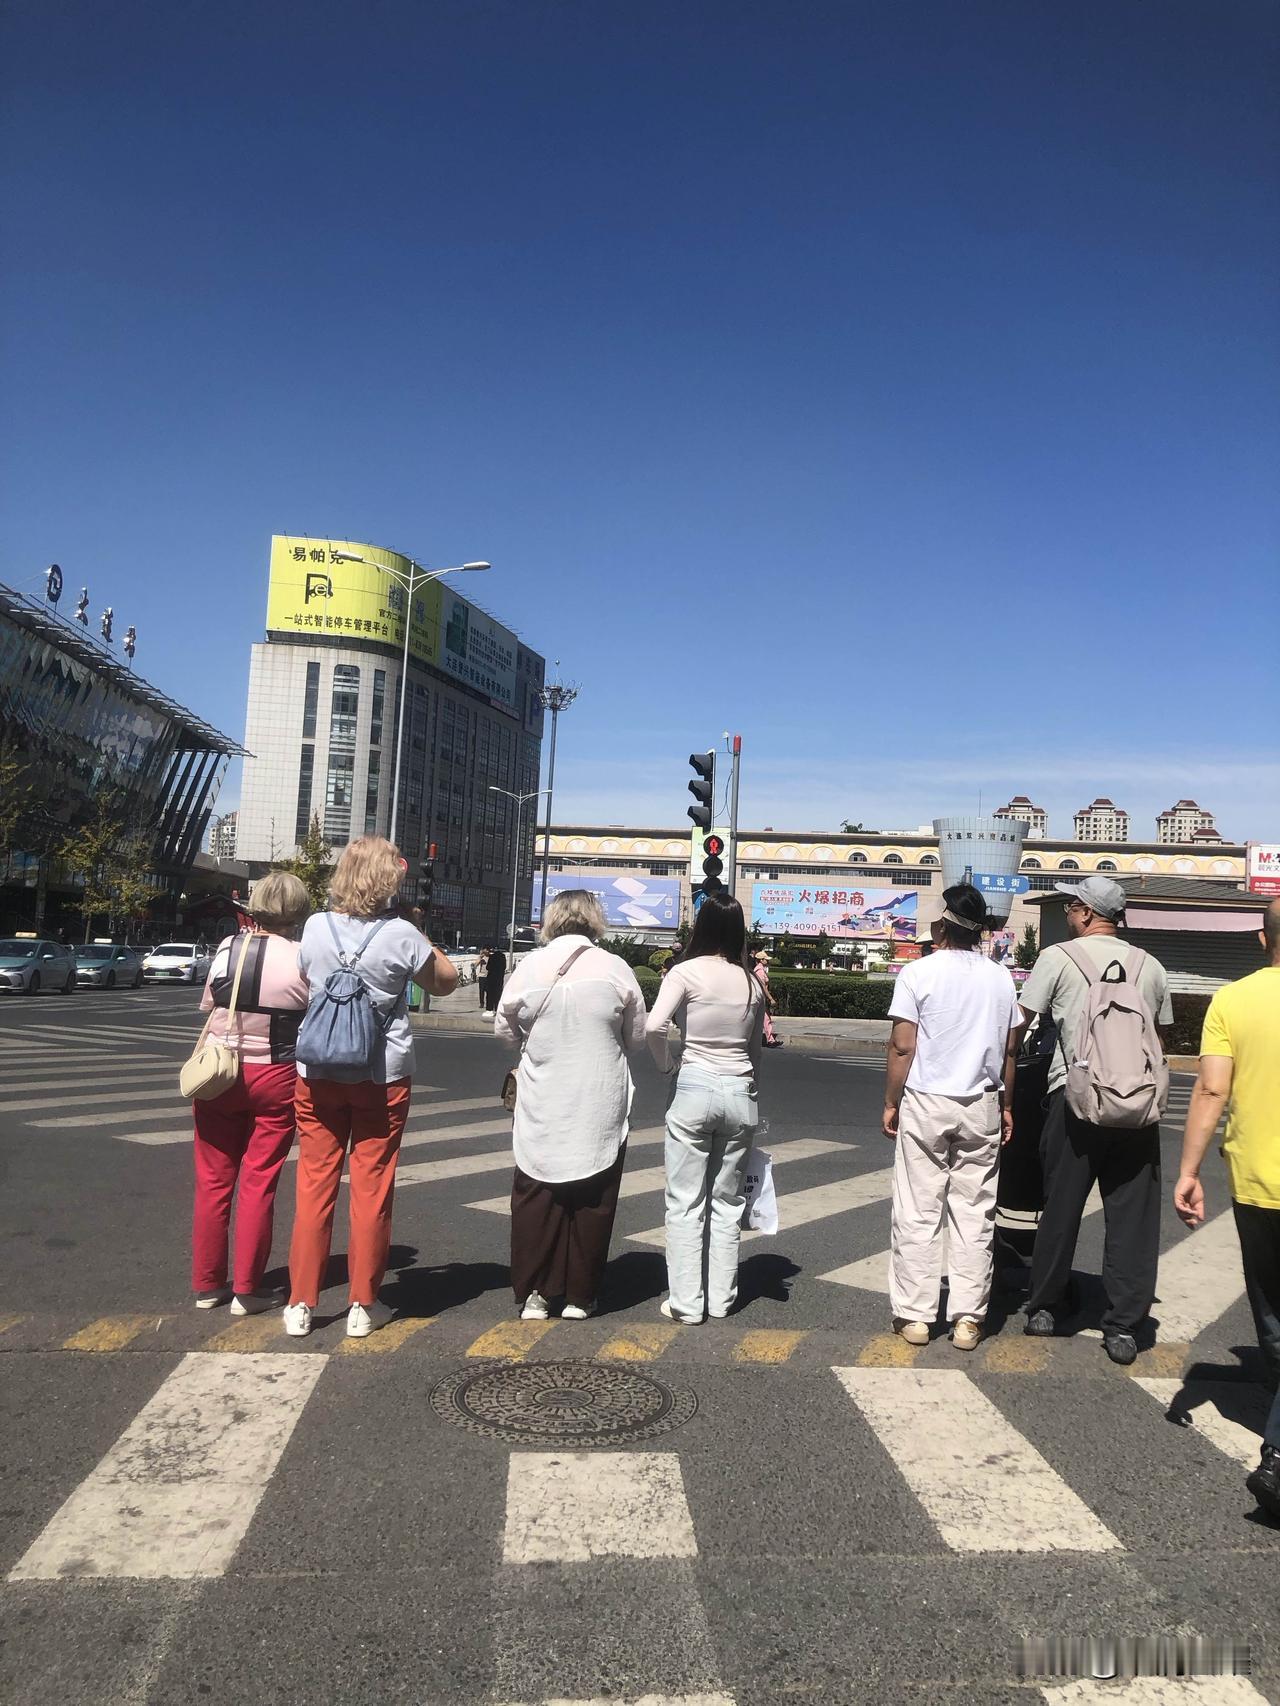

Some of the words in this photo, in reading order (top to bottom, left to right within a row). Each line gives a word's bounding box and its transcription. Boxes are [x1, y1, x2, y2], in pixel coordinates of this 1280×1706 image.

[284, 613, 389, 636] 一站式智能停车管理平台
[981, 876, 1020, 887] 建设街
[798, 889, 865, 906] 火爆招商
